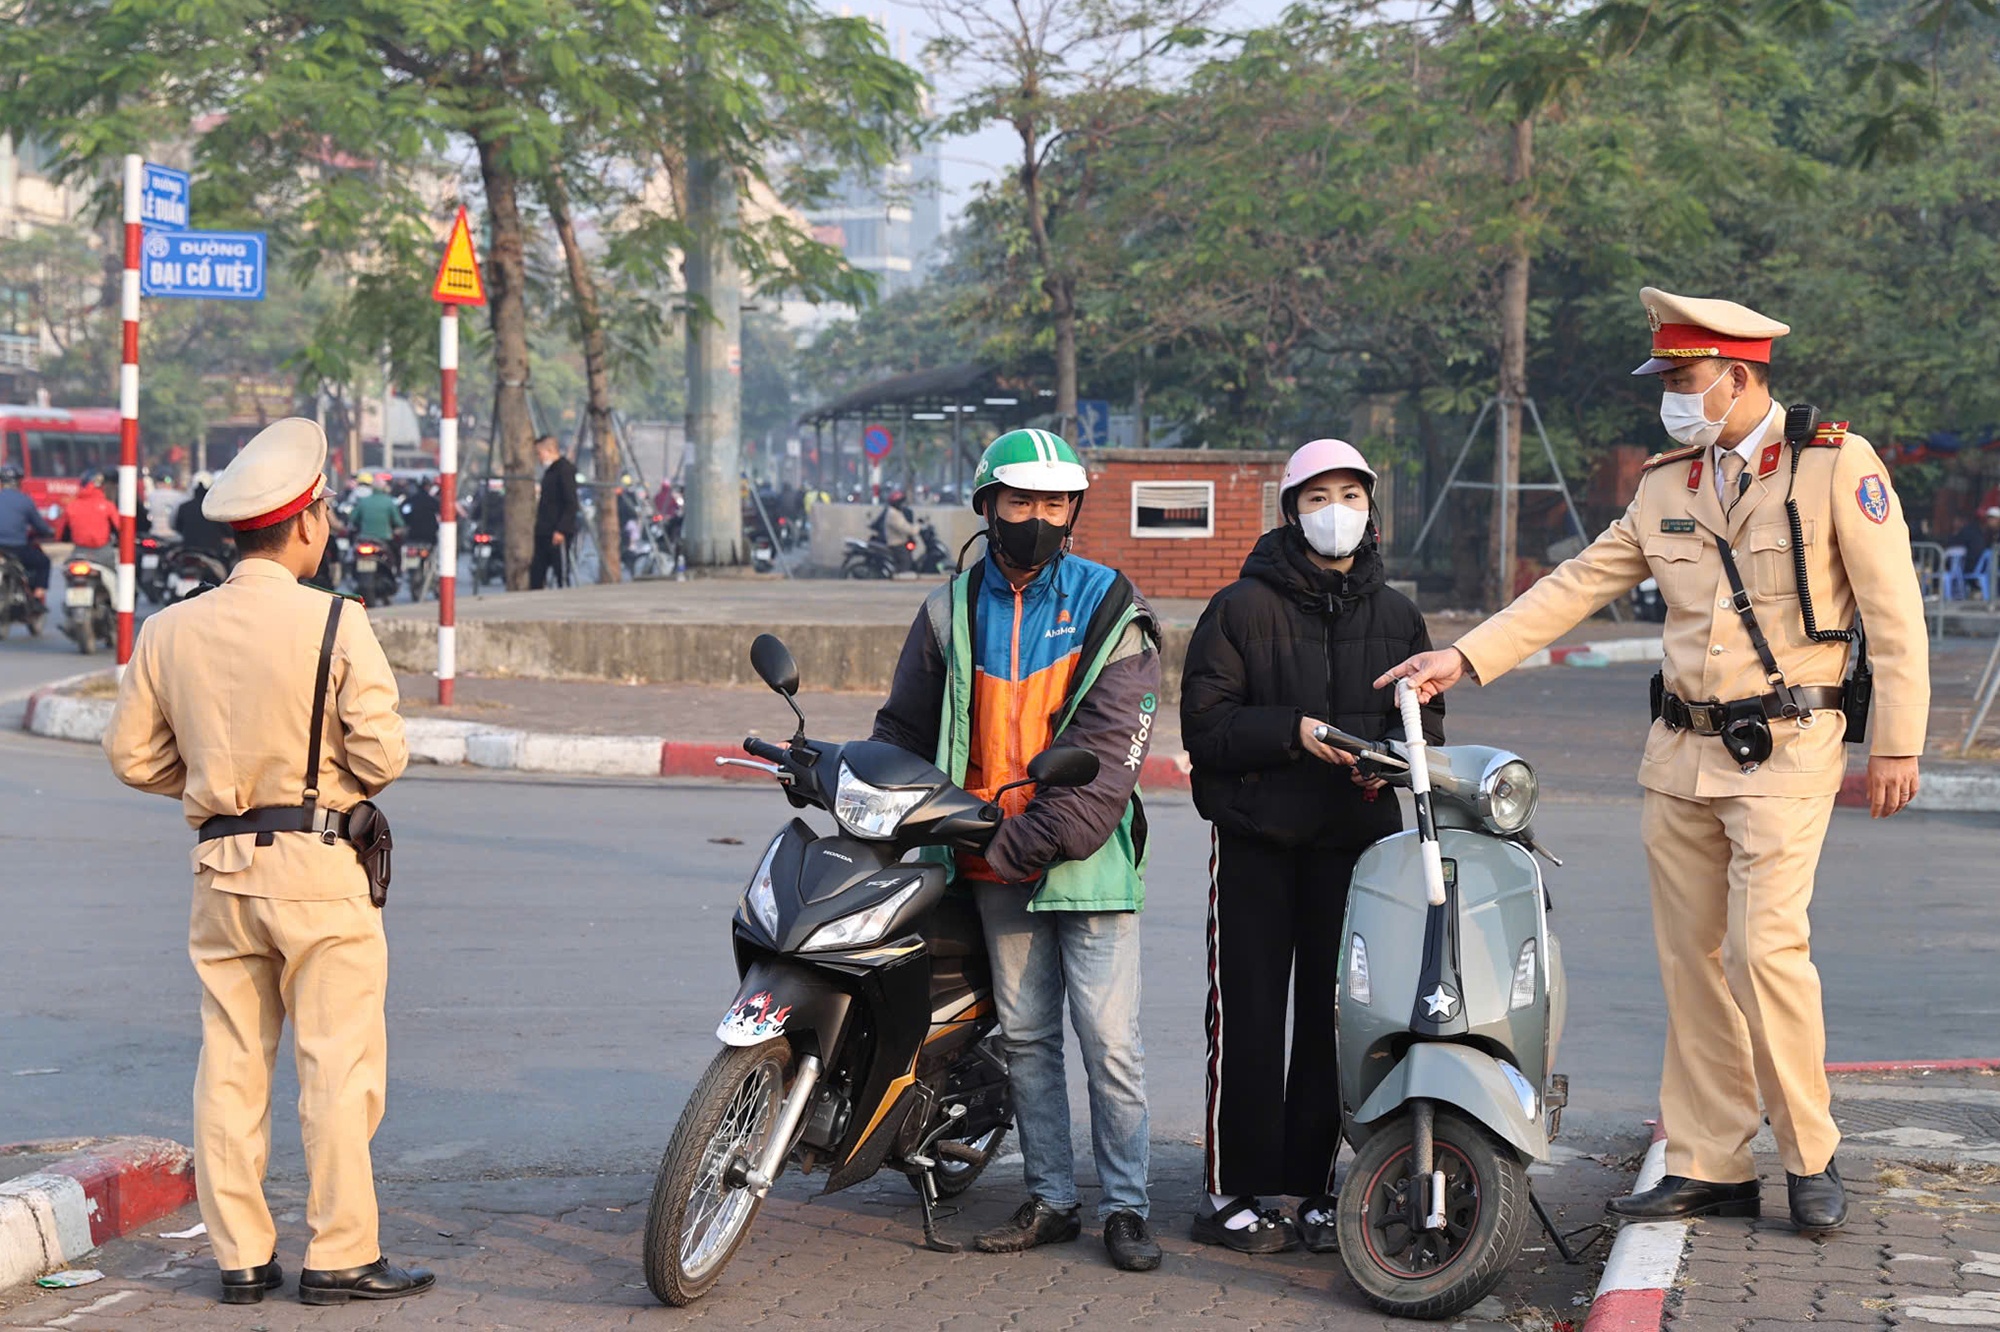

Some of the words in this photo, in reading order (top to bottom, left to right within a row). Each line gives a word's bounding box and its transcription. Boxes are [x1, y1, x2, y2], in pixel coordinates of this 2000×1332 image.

[180, 240, 247, 257] ĐƯỜNG
[214, 260, 254, 293] VIỆT
[1124, 713, 1151, 771] gojek
[823, 850, 853, 863] HONDA
